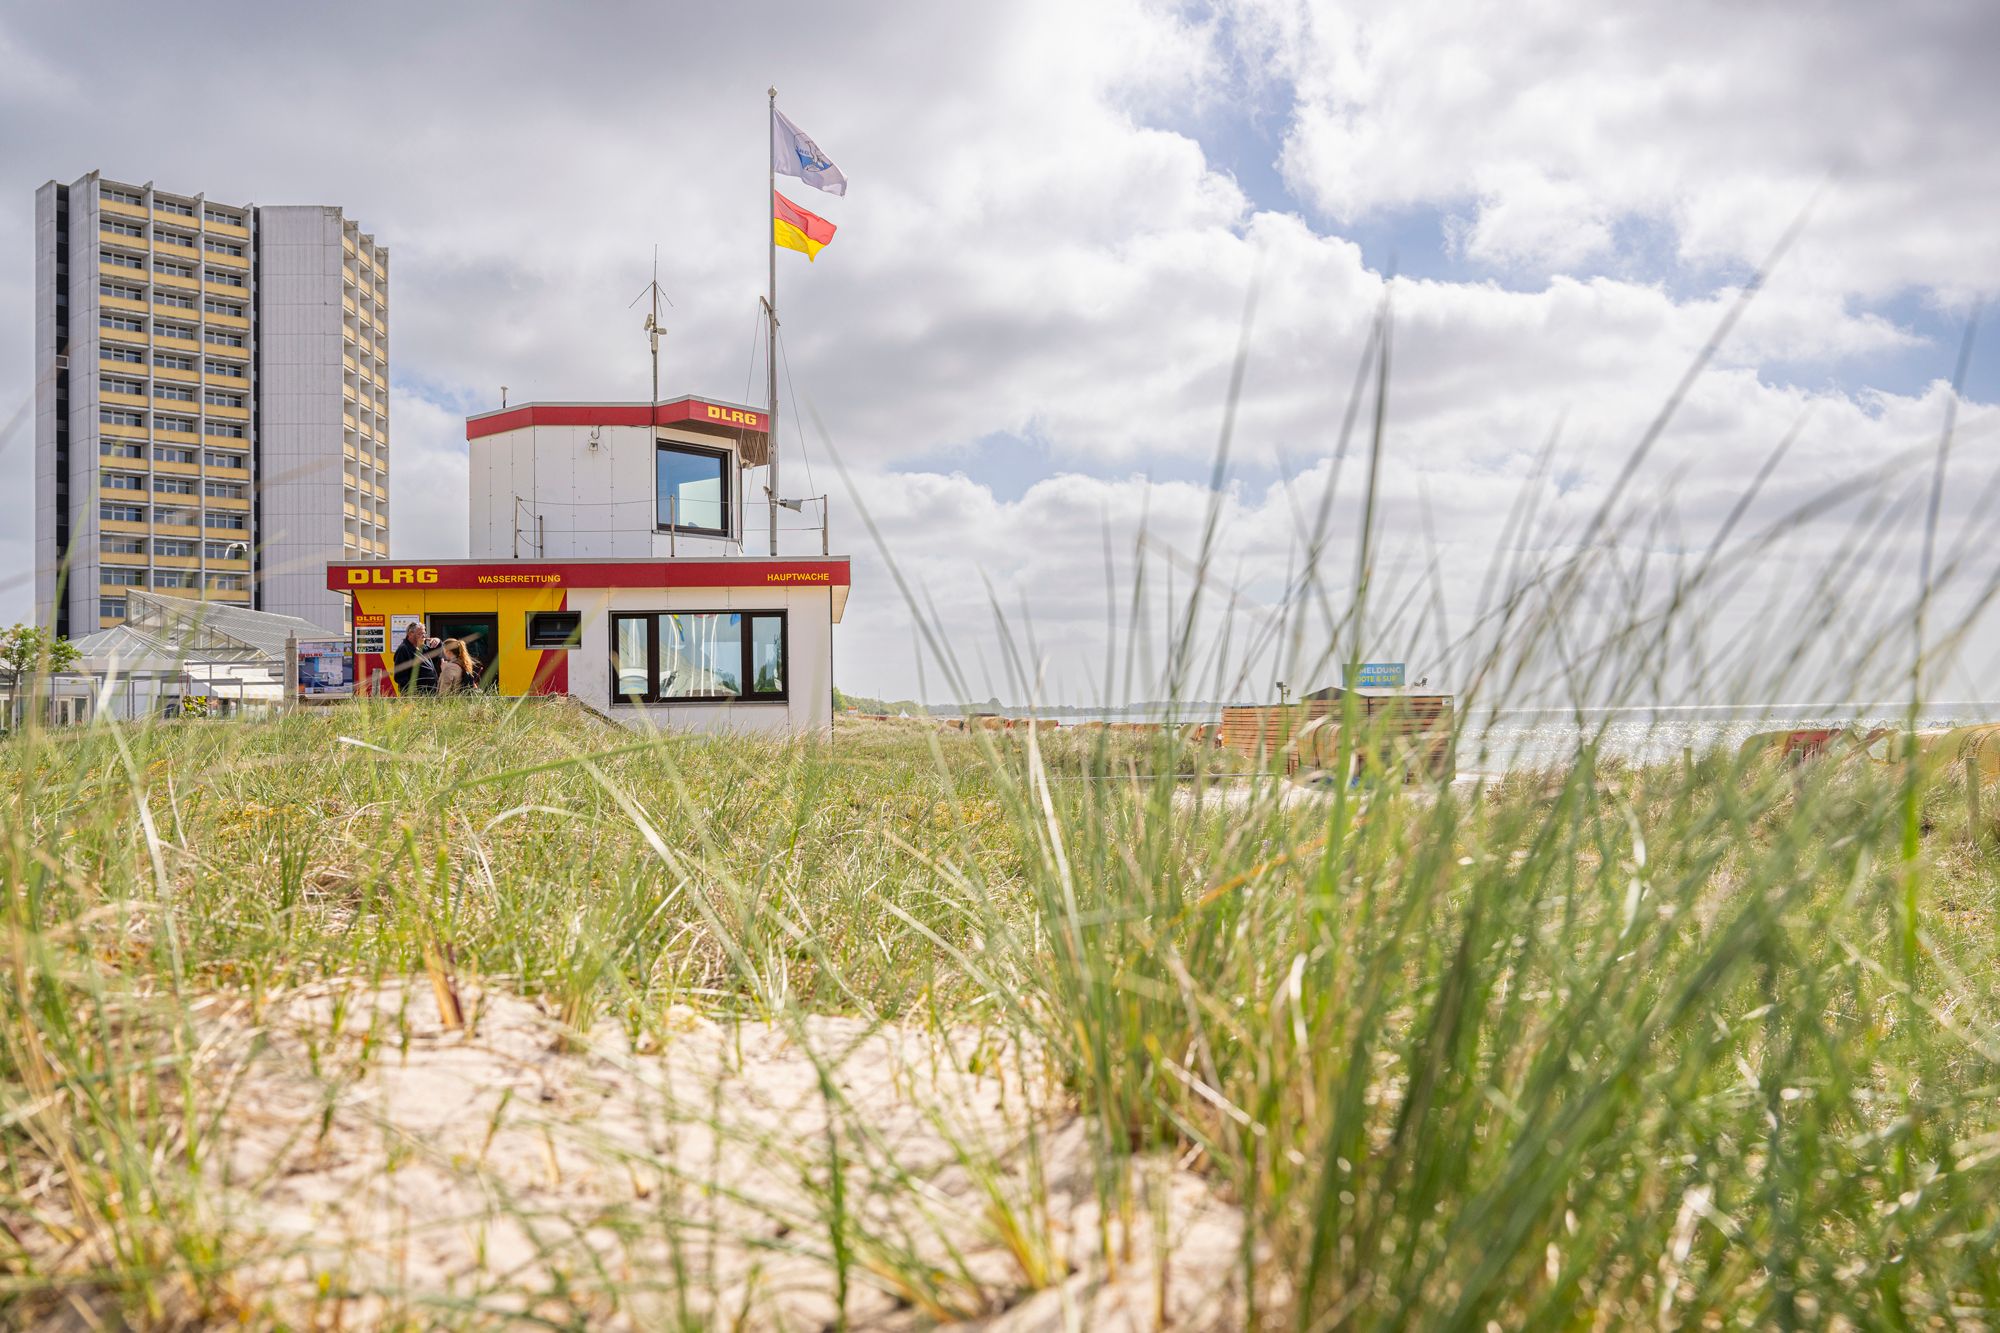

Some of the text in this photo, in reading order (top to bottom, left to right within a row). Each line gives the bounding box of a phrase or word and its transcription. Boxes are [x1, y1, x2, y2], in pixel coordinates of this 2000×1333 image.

[708, 406, 757, 426] DLRG
[348, 568, 438, 584] DLRG
[478, 574, 561, 584] WASSERRETTUNG
[767, 573, 830, 582] HAUPTWACHE
